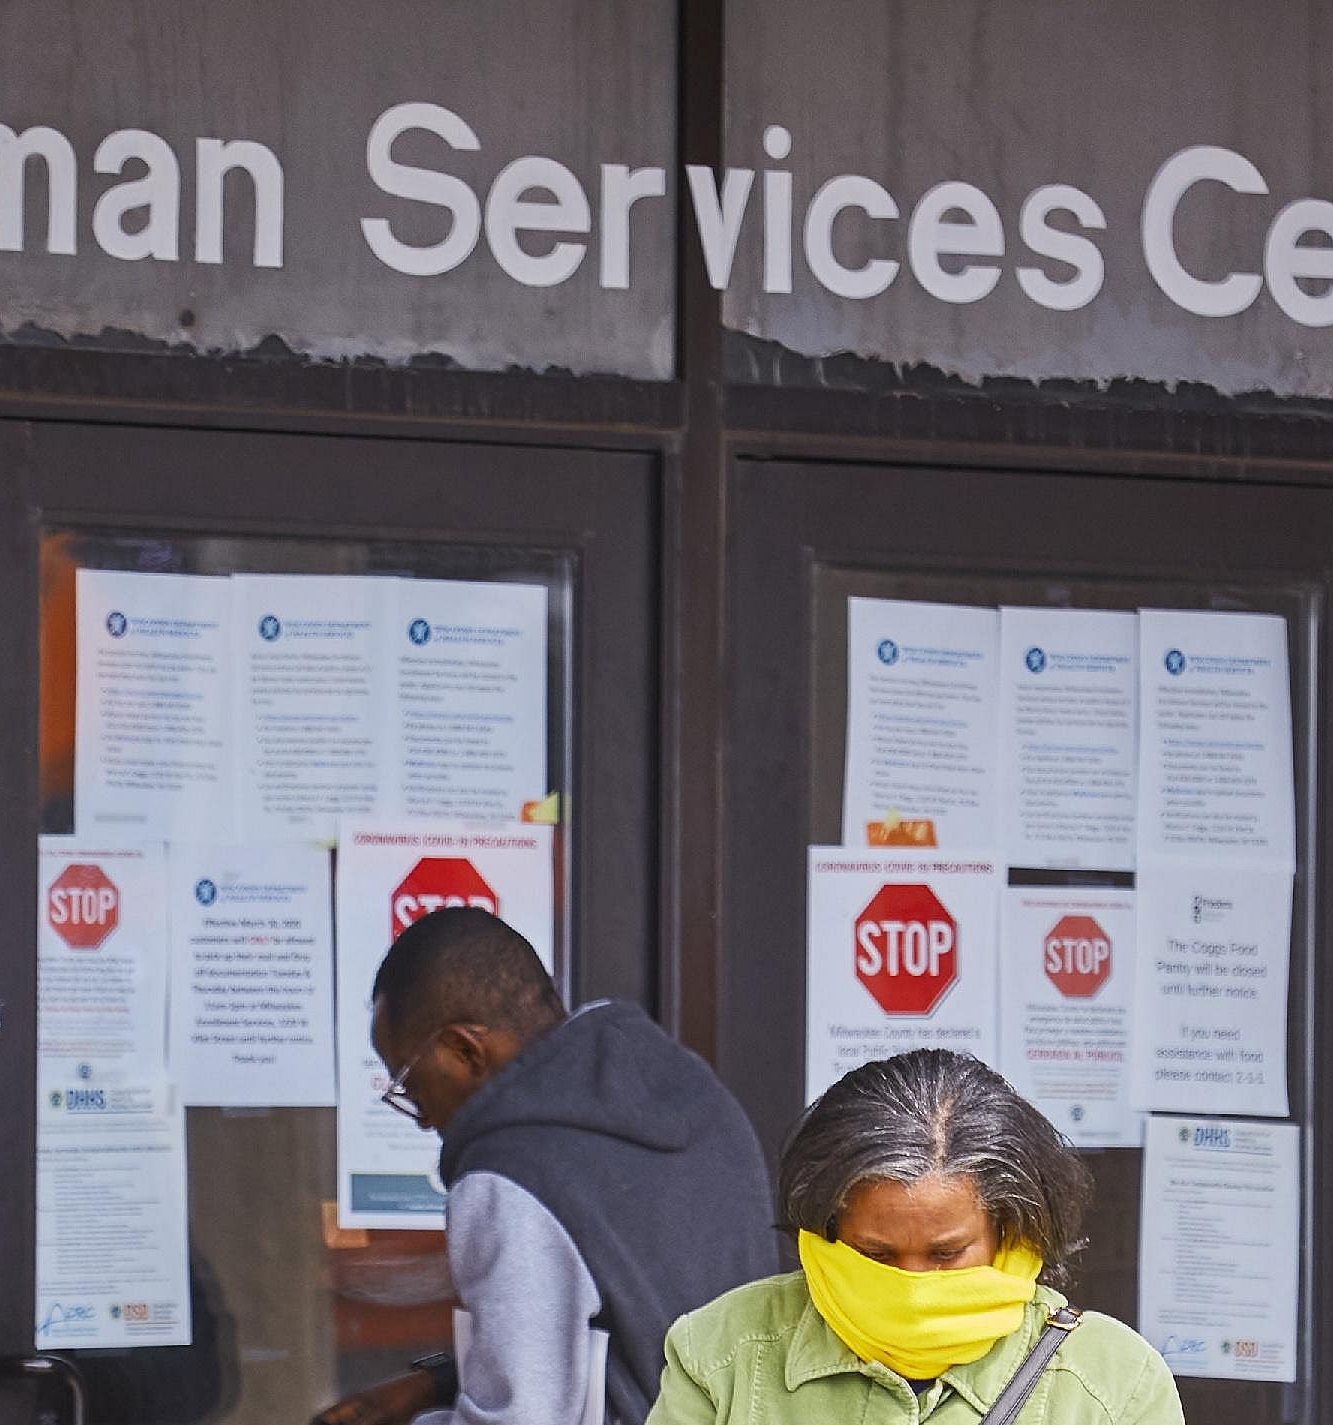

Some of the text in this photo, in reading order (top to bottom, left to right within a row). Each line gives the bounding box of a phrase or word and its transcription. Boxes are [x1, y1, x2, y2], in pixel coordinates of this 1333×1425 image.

[360, 102, 1106, 310] Services
[51, 887, 116, 925] STOP
[857, 919, 953, 977] STOP
[1046, 937, 1109, 974] STOP
[1166, 939, 1259, 957] The Coggs Food
[1155, 961, 1190, 977] Pantry
[1194, 963, 1213, 976] will
[67, 1089, 108, 1111] DHHS
